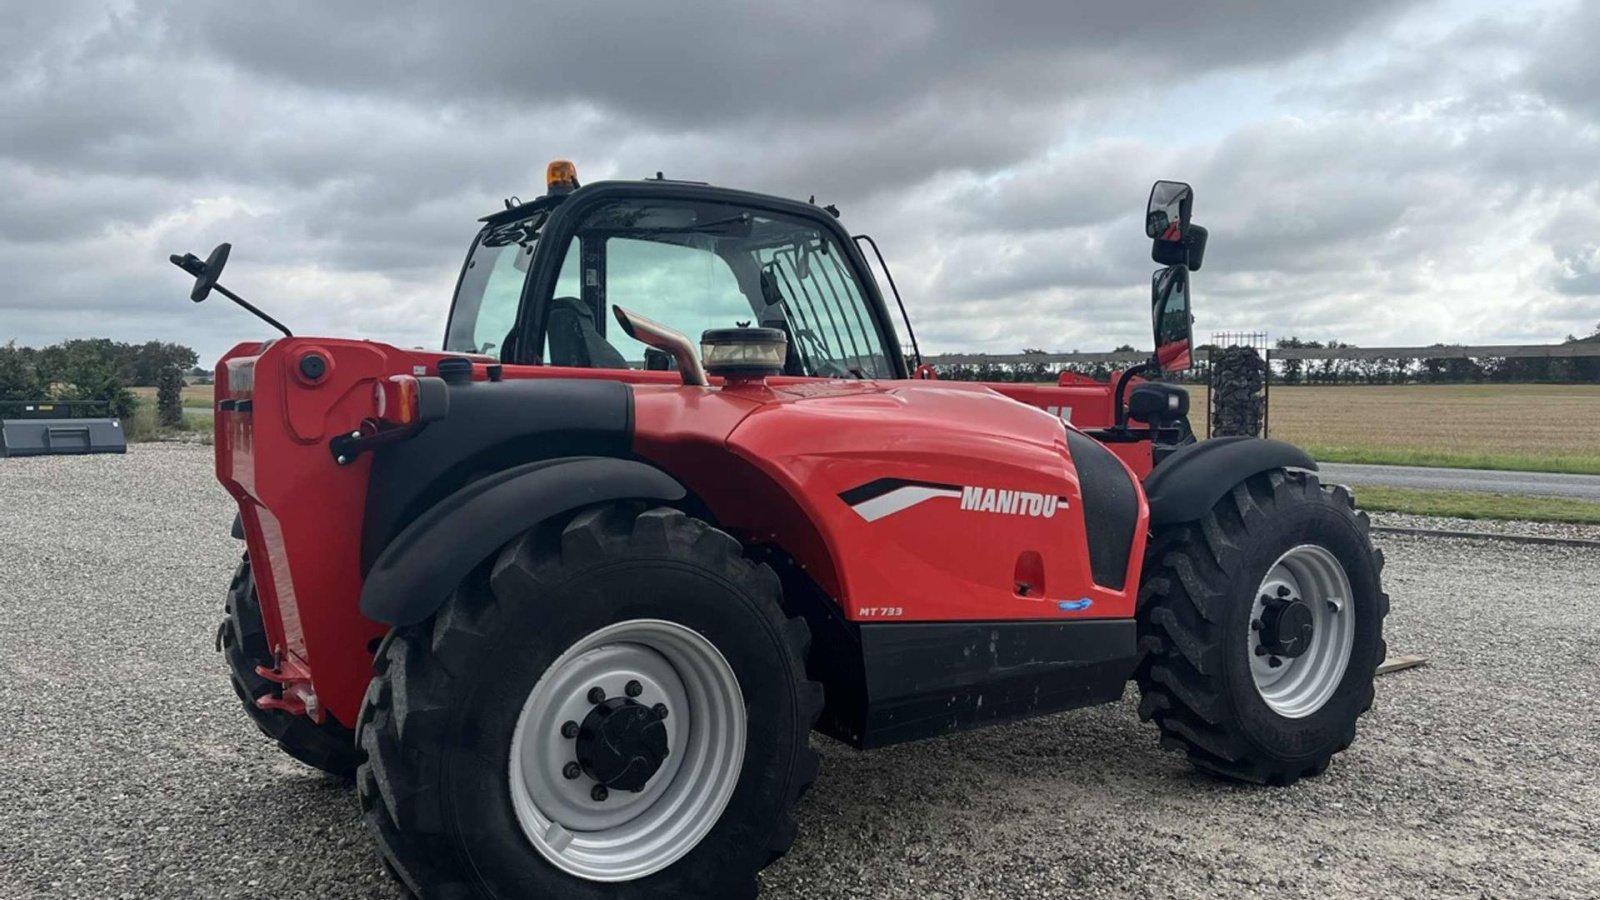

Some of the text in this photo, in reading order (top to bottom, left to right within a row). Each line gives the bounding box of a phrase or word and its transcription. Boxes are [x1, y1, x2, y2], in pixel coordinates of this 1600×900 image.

[961, 486, 1058, 518] MANITOU
[859, 607, 903, 616] MT 733
